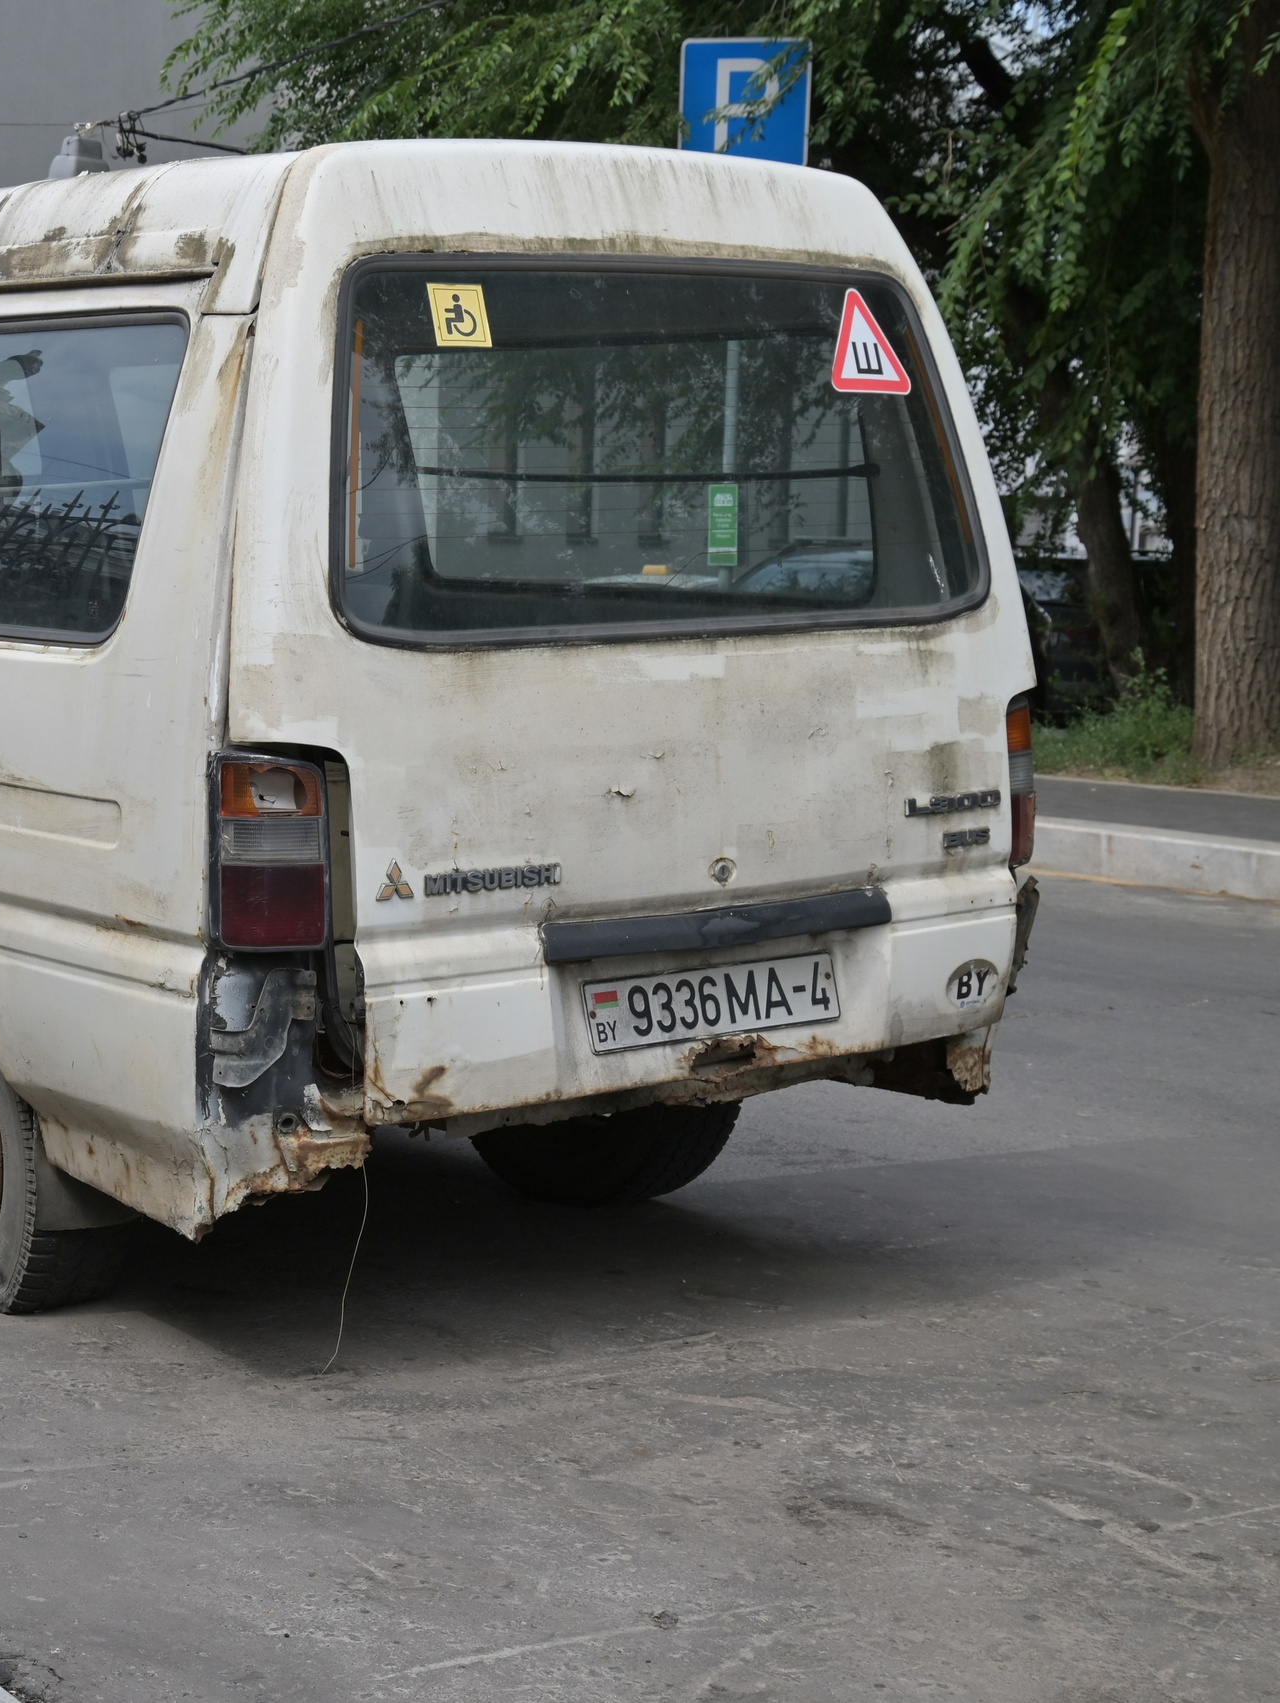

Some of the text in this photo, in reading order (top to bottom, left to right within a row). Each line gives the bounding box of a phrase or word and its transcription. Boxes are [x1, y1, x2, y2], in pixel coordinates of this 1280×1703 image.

[715, 58, 779, 154] P
[851, 341, 884, 376] Ш
[904, 789, 1001, 817] L300
[943, 826, 990, 848] BUS
[424, 862, 561, 897] MITSUBISHI
[956, 968, 991, 1000] BY
[596, 1020, 618, 1043] BY
